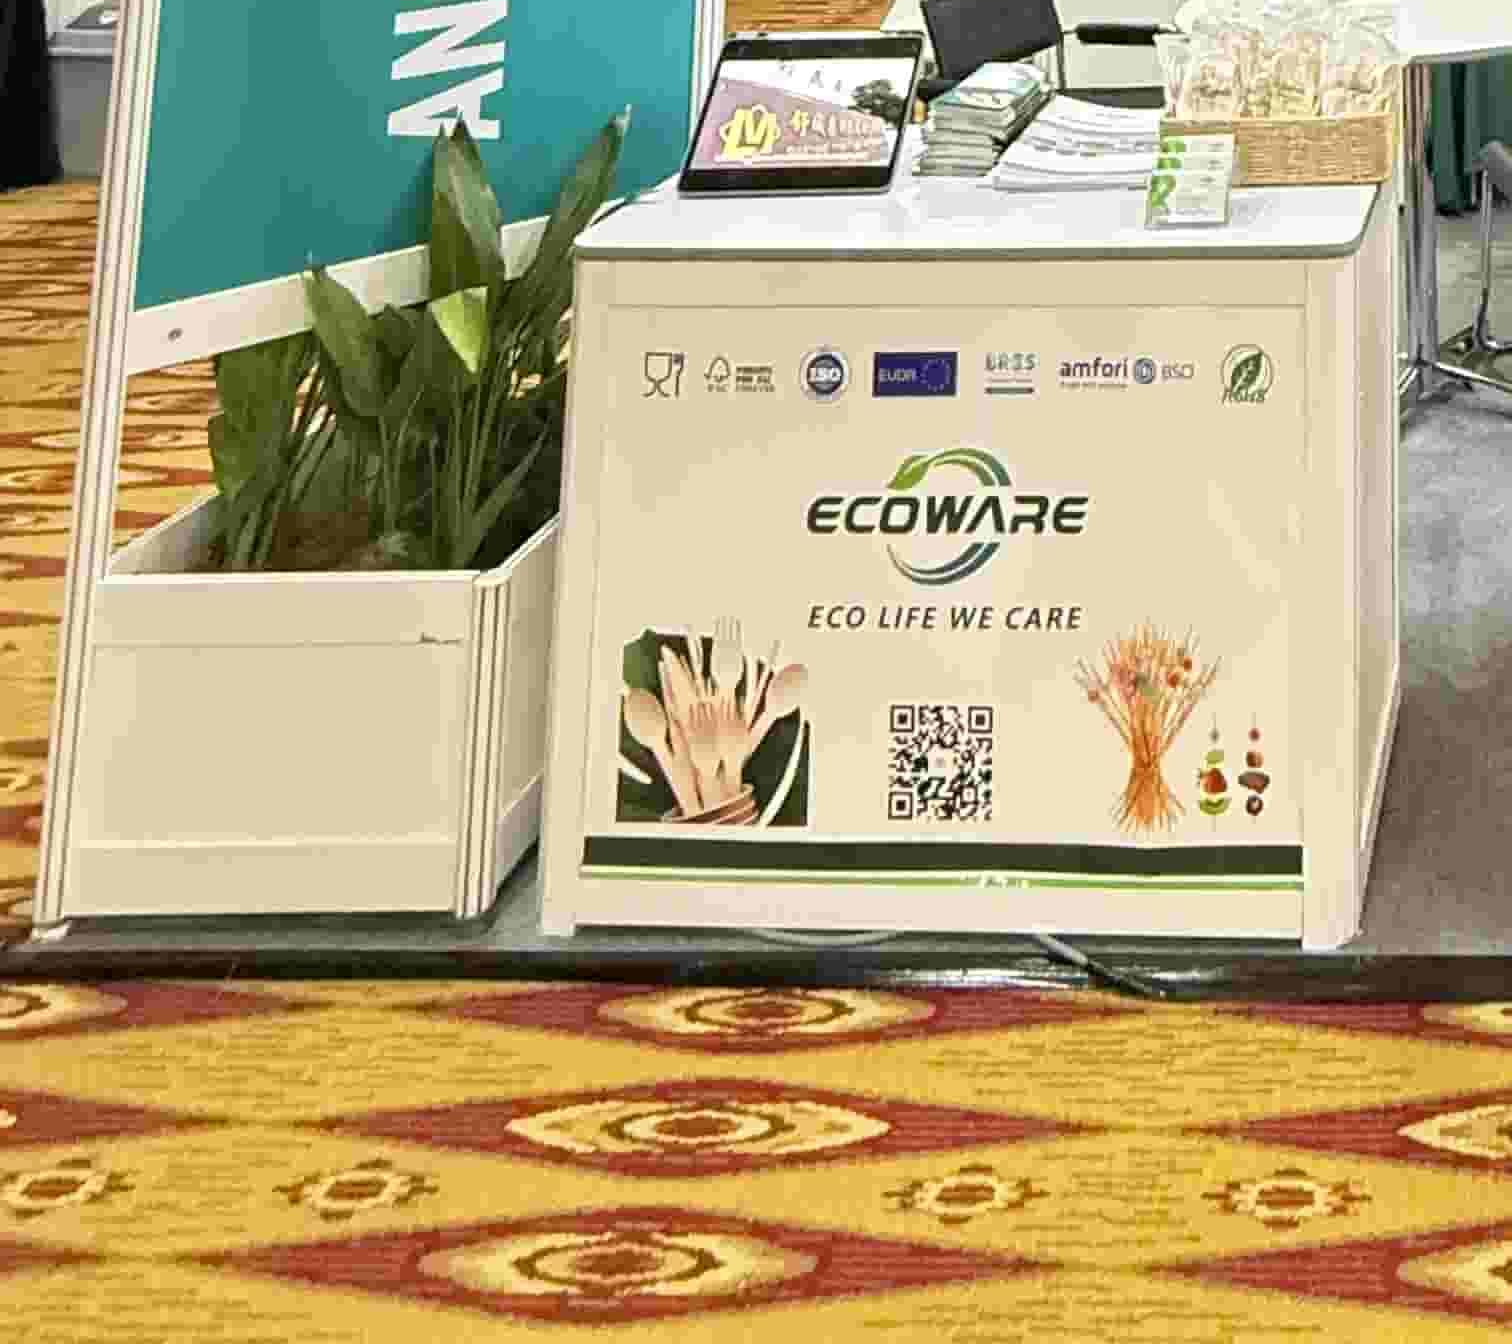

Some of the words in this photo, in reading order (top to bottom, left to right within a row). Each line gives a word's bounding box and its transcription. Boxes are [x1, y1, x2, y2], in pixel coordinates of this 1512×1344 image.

[1060, 356, 1128, 379] amfori
[806, 495, 1089, 535] ECOWARE
[808, 605, 866, 630] ECO
[878, 605, 937, 630] LIFE
[950, 606, 994, 630] WE
[1005, 606, 1082, 630] CARE
